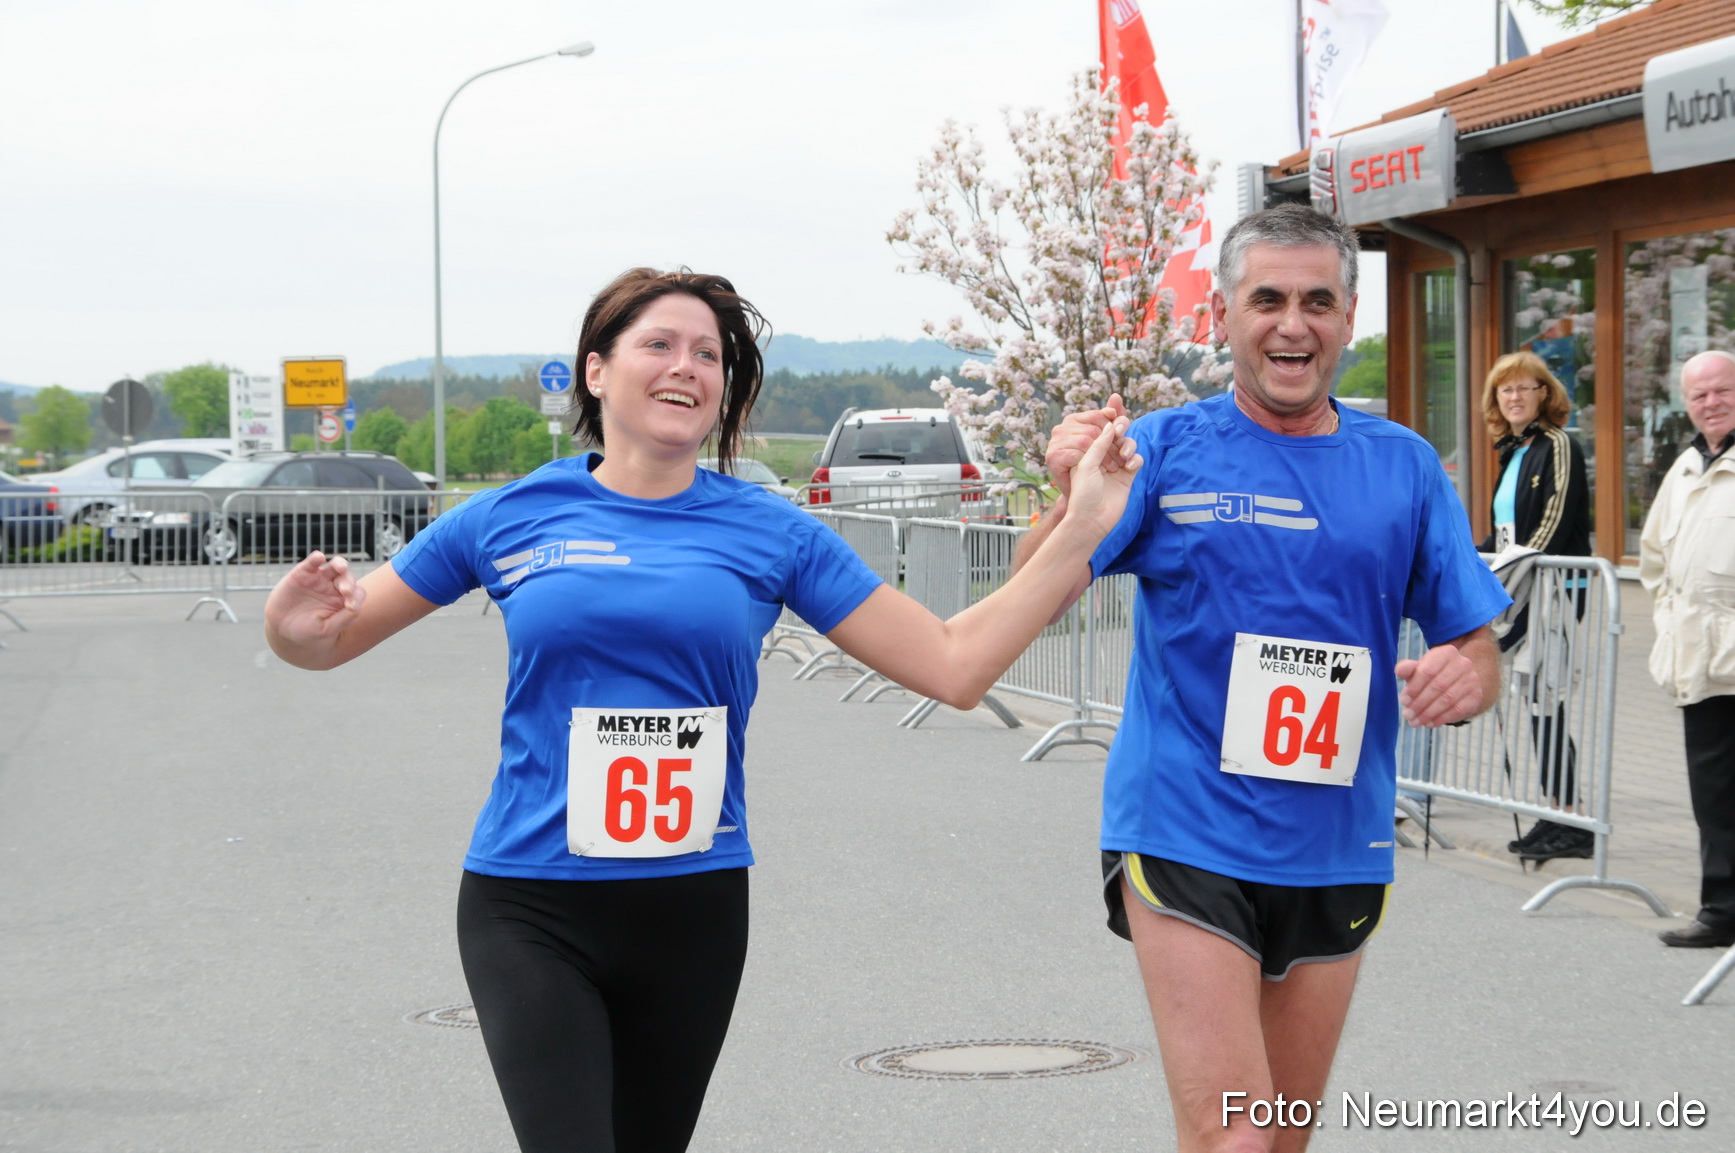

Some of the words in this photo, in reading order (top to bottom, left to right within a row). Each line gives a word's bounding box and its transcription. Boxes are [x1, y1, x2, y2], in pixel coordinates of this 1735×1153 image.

[1665, 77, 1735, 133] Autoh
[1350, 144, 1425, 193] SEAT
[1259, 643, 1328, 666] MEYER
[1259, 659, 1327, 679] WERBUNG
[597, 715, 672, 733] MEYER
[597, 734, 672, 747] WERBUNG
[1263, 684, 1341, 770] 64
[604, 756, 693, 843] 65
